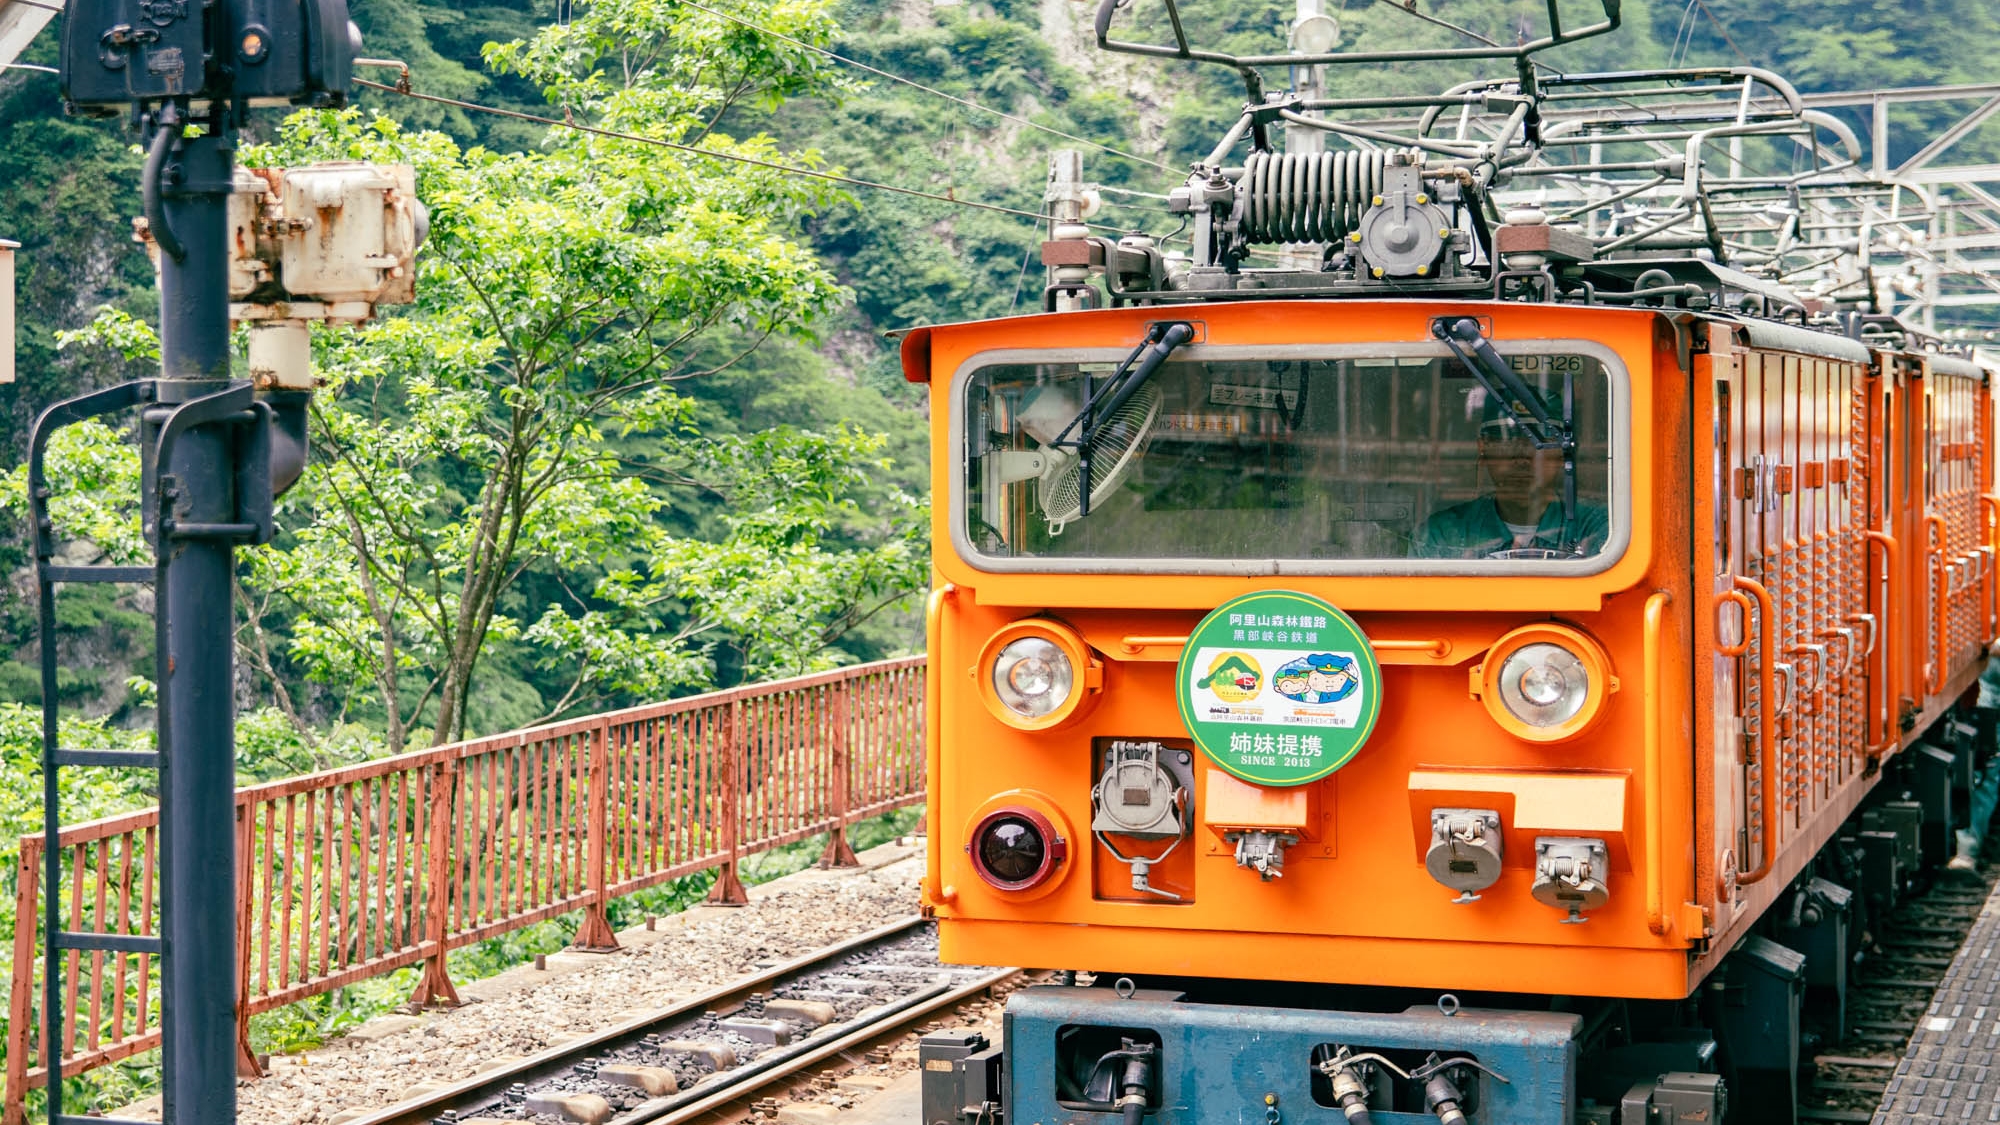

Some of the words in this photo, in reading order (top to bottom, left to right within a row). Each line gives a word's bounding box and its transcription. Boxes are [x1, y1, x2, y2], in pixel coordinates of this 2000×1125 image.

[1511, 355, 1580, 371] EDR26
[1229, 613, 1327, 629] 阿里山森林鐵路
[1229, 731, 1323, 757] 姉妹提携
[1240, 757, 1276, 767] SINCE
[1284, 757, 1311, 768] 2013
